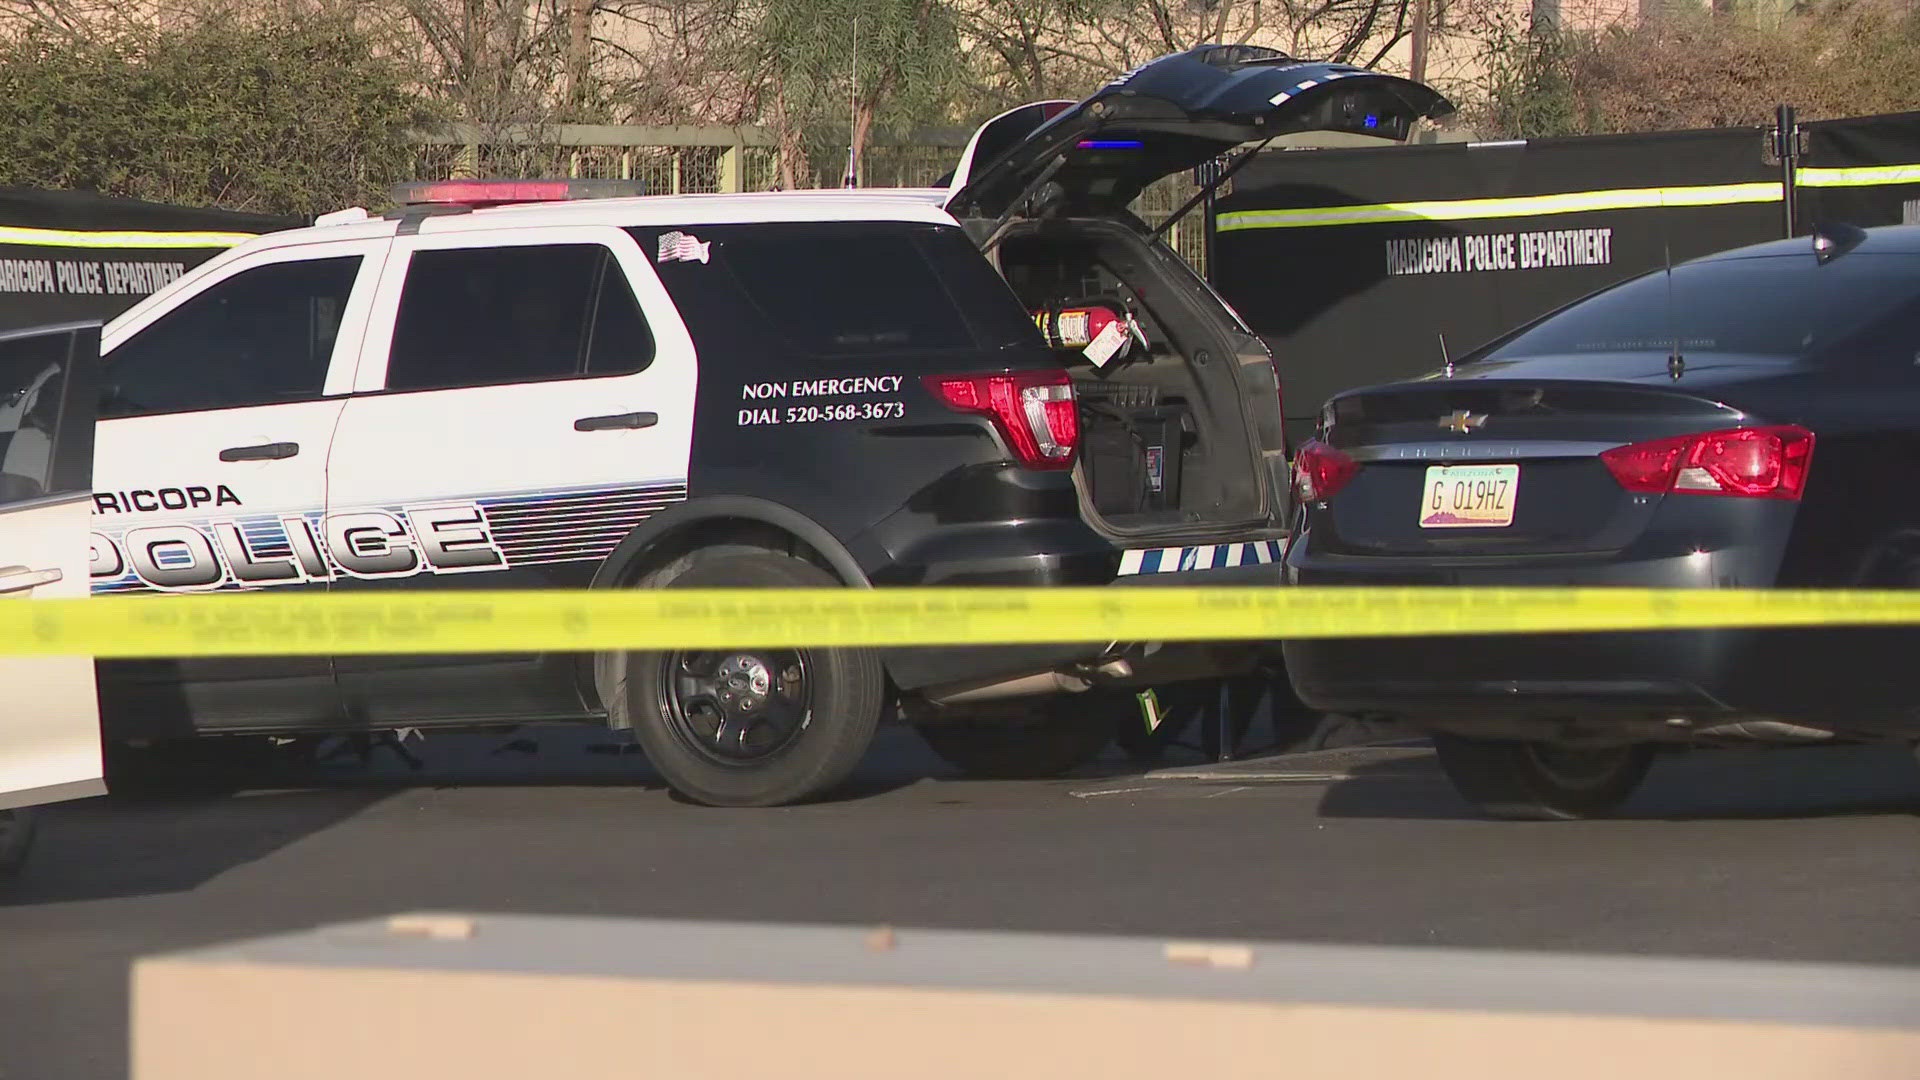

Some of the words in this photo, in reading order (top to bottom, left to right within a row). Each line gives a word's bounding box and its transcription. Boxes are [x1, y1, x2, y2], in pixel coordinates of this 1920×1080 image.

[1385, 236, 1462, 276] MARICOPA
[1465, 232, 1517, 272] POLICE
[1519, 228, 1613, 270] DEPARTMENT
[56, 260, 103, 294] POLICE
[742, 382, 788, 400] NON
[792, 375, 903, 397] EMERGENCY
[737, 408, 781, 426] DIAL
[786, 401, 905, 424] 520-568-3673
[92, 484, 243, 515] RICOPA
[1432, 481, 1444, 510] G
[1453, 480, 1508, 510] 019HZ
